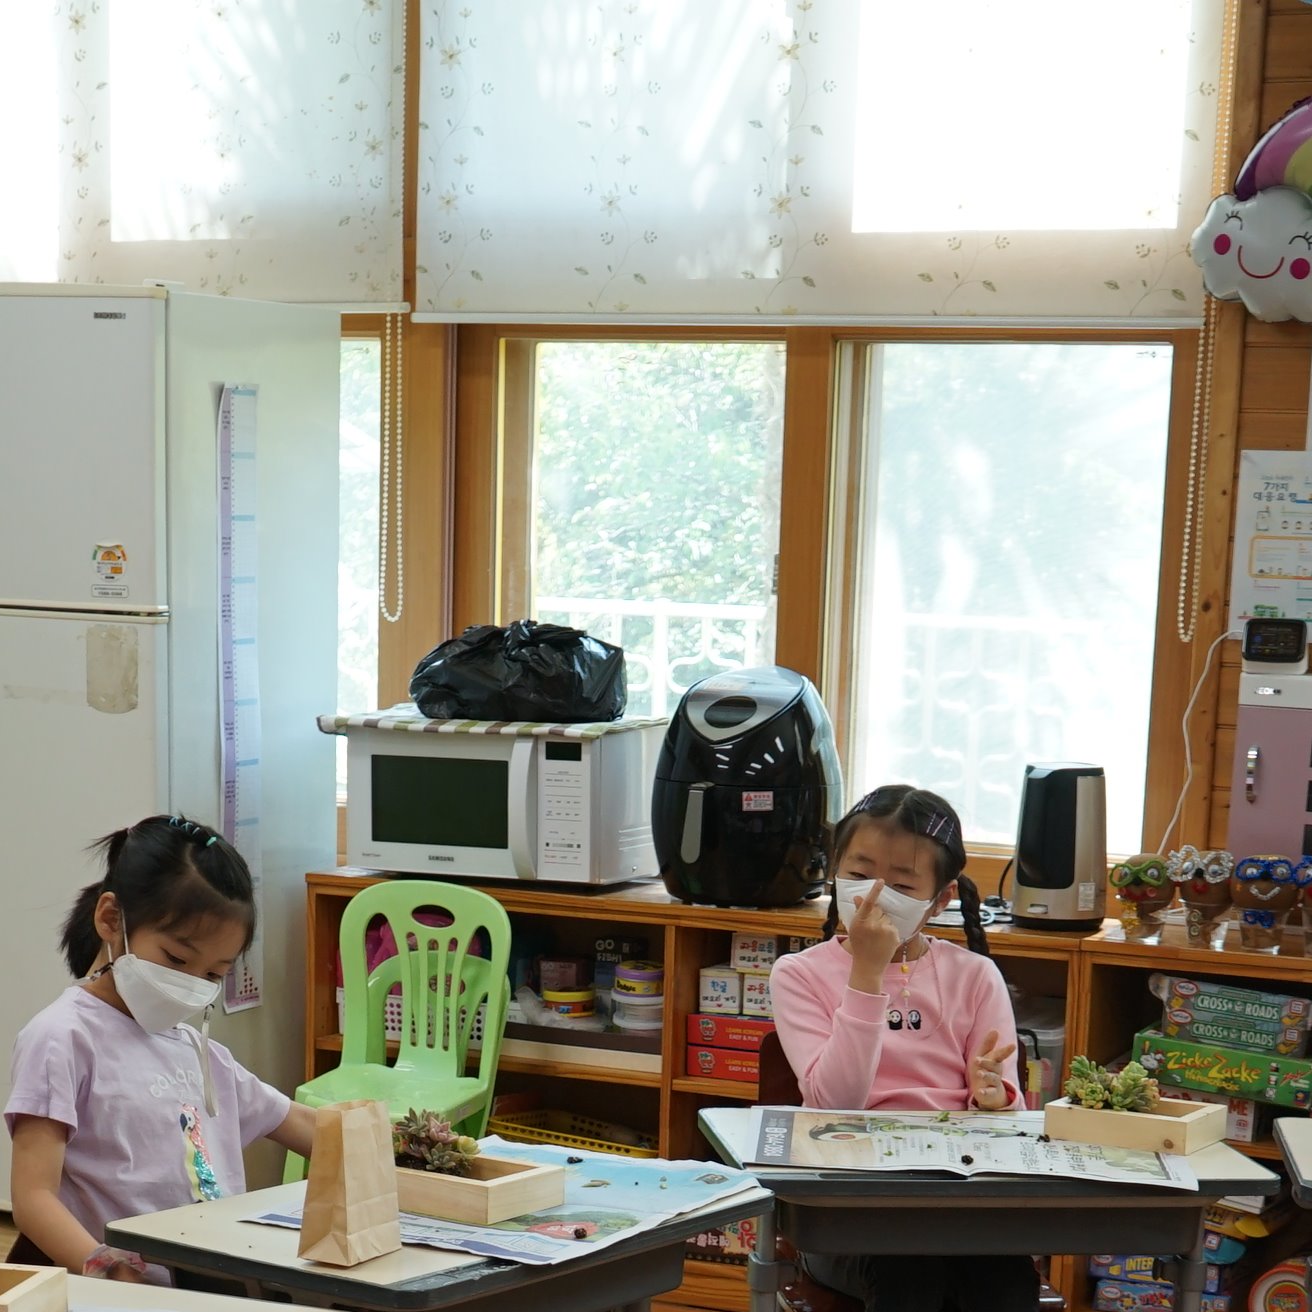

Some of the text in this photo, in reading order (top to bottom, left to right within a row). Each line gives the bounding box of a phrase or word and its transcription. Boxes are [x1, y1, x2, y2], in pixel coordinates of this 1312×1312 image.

[1263, 481, 1289, 492] 7가지
[1253, 491, 1297, 503] 대응요령
[595, 939, 615, 951] GO
[739, 939, 775, 954] 자음모음
[710, 979, 728, 993] 한글
[702, 994, 737, 1003] 메모리 게임
[1197, 994, 1279, 1020] CROSS ROADS
[1192, 1022, 1274, 1047] CROSS ROADS
[742, 1060, 759, 1068] KOREA
[1166, 1051, 1213, 1070] Zicke
[1208, 1053, 1262, 1084] Zacke
